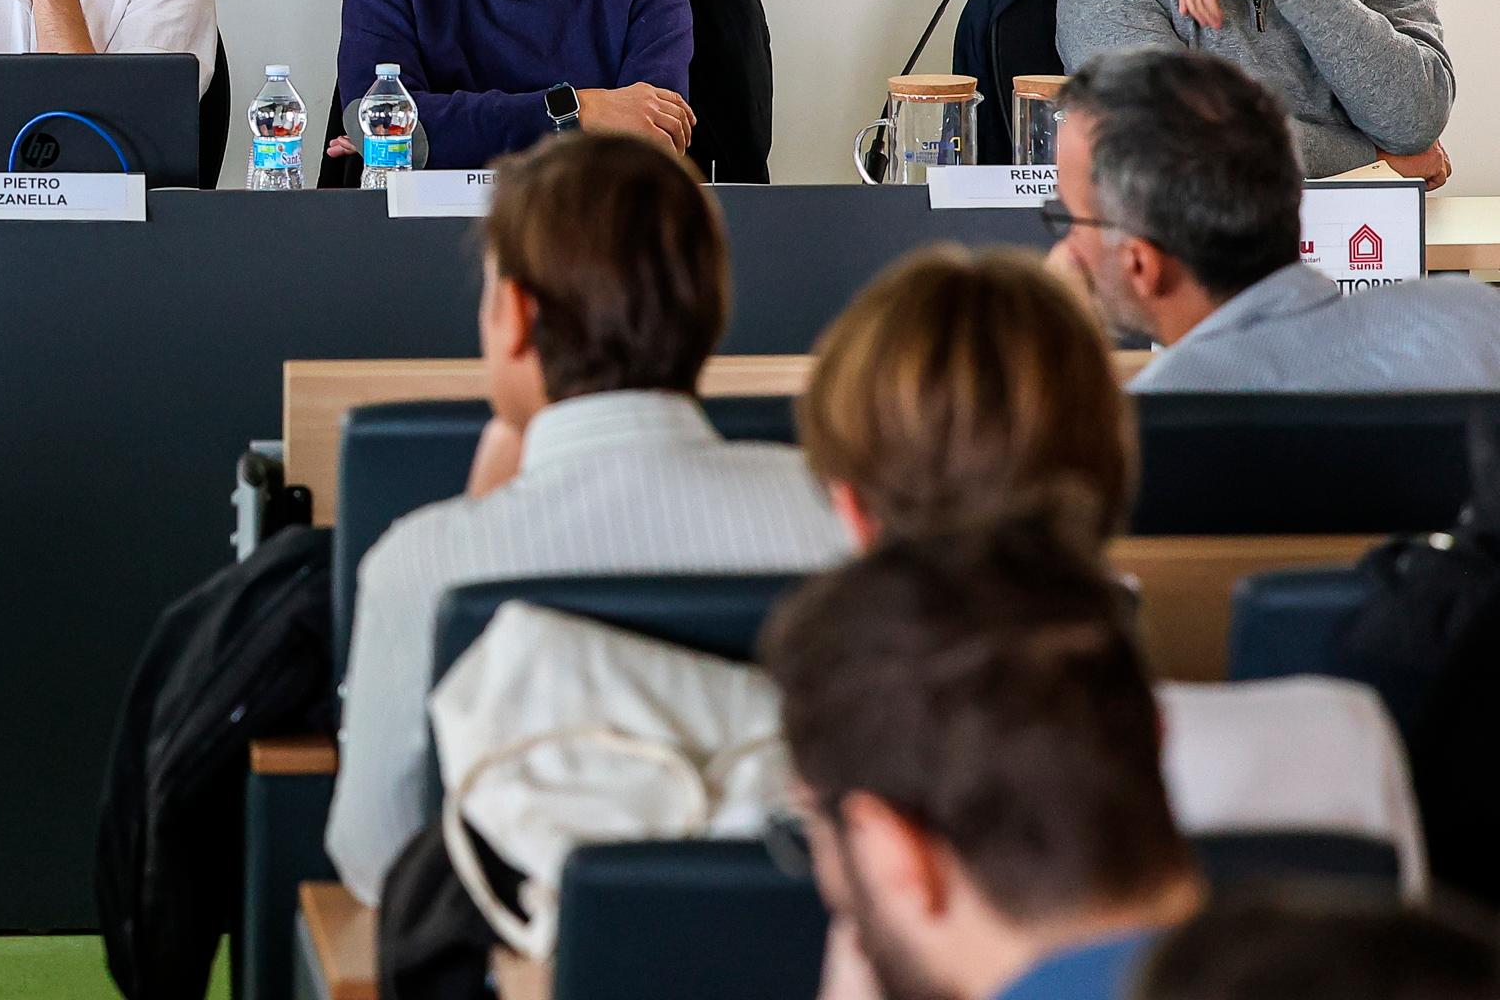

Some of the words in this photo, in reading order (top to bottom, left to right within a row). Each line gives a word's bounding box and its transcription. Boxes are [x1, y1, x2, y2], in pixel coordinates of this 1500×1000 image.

[25, 133, 56, 168] hp
[1010, 169, 1059, 180] RENAT
[3, 177, 60, 190] PIETRO
[1349, 263, 1383, 271] sunia
